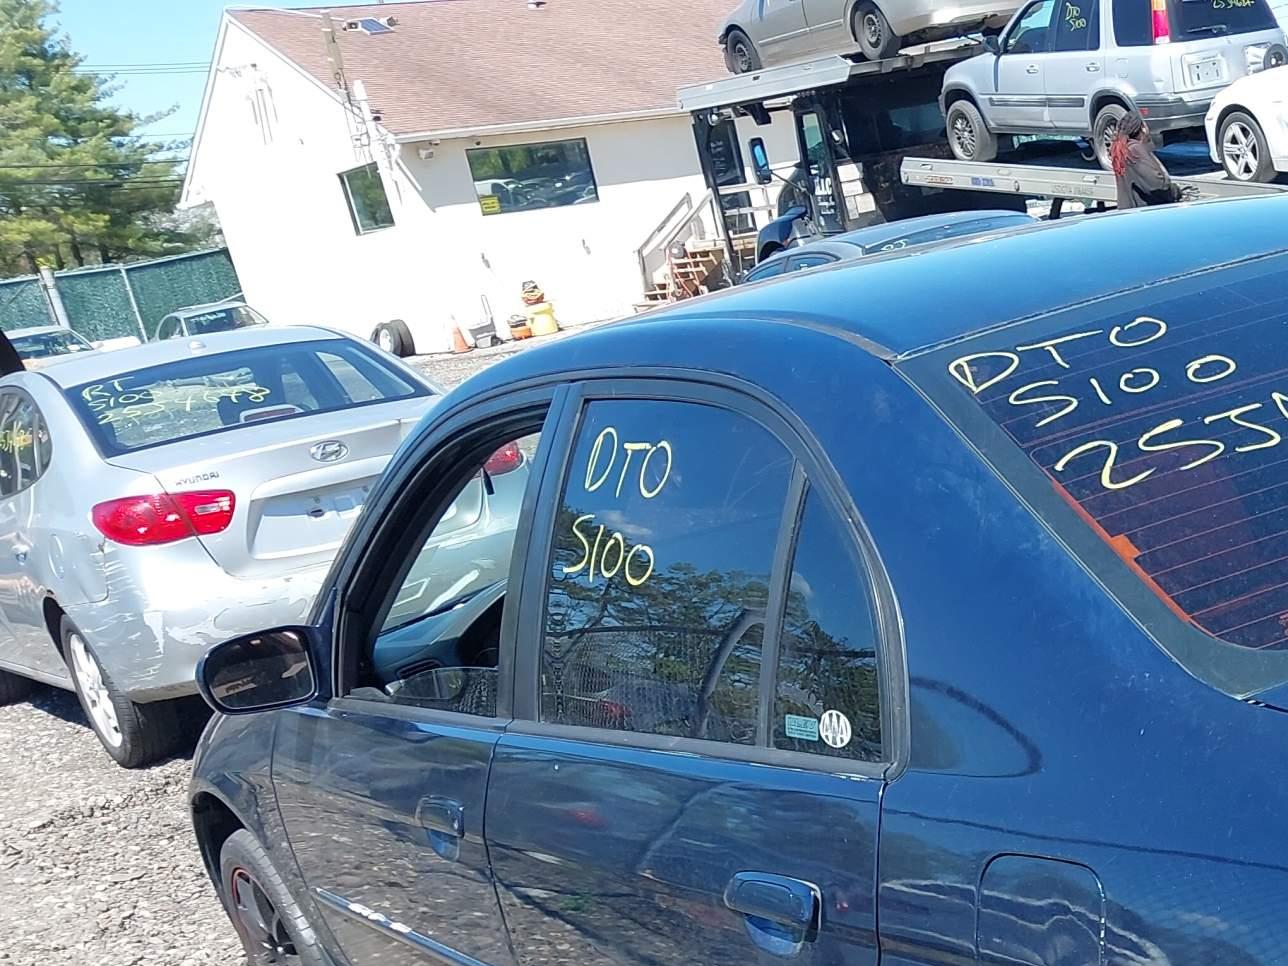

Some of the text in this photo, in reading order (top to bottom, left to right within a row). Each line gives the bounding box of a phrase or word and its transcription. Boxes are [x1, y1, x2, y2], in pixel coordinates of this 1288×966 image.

[948, 317, 1167, 393] DTO
[82, 376, 135, 401] RT
[175, 471, 220, 487] HYUNDAI
[585, 426, 672, 498] DTO
